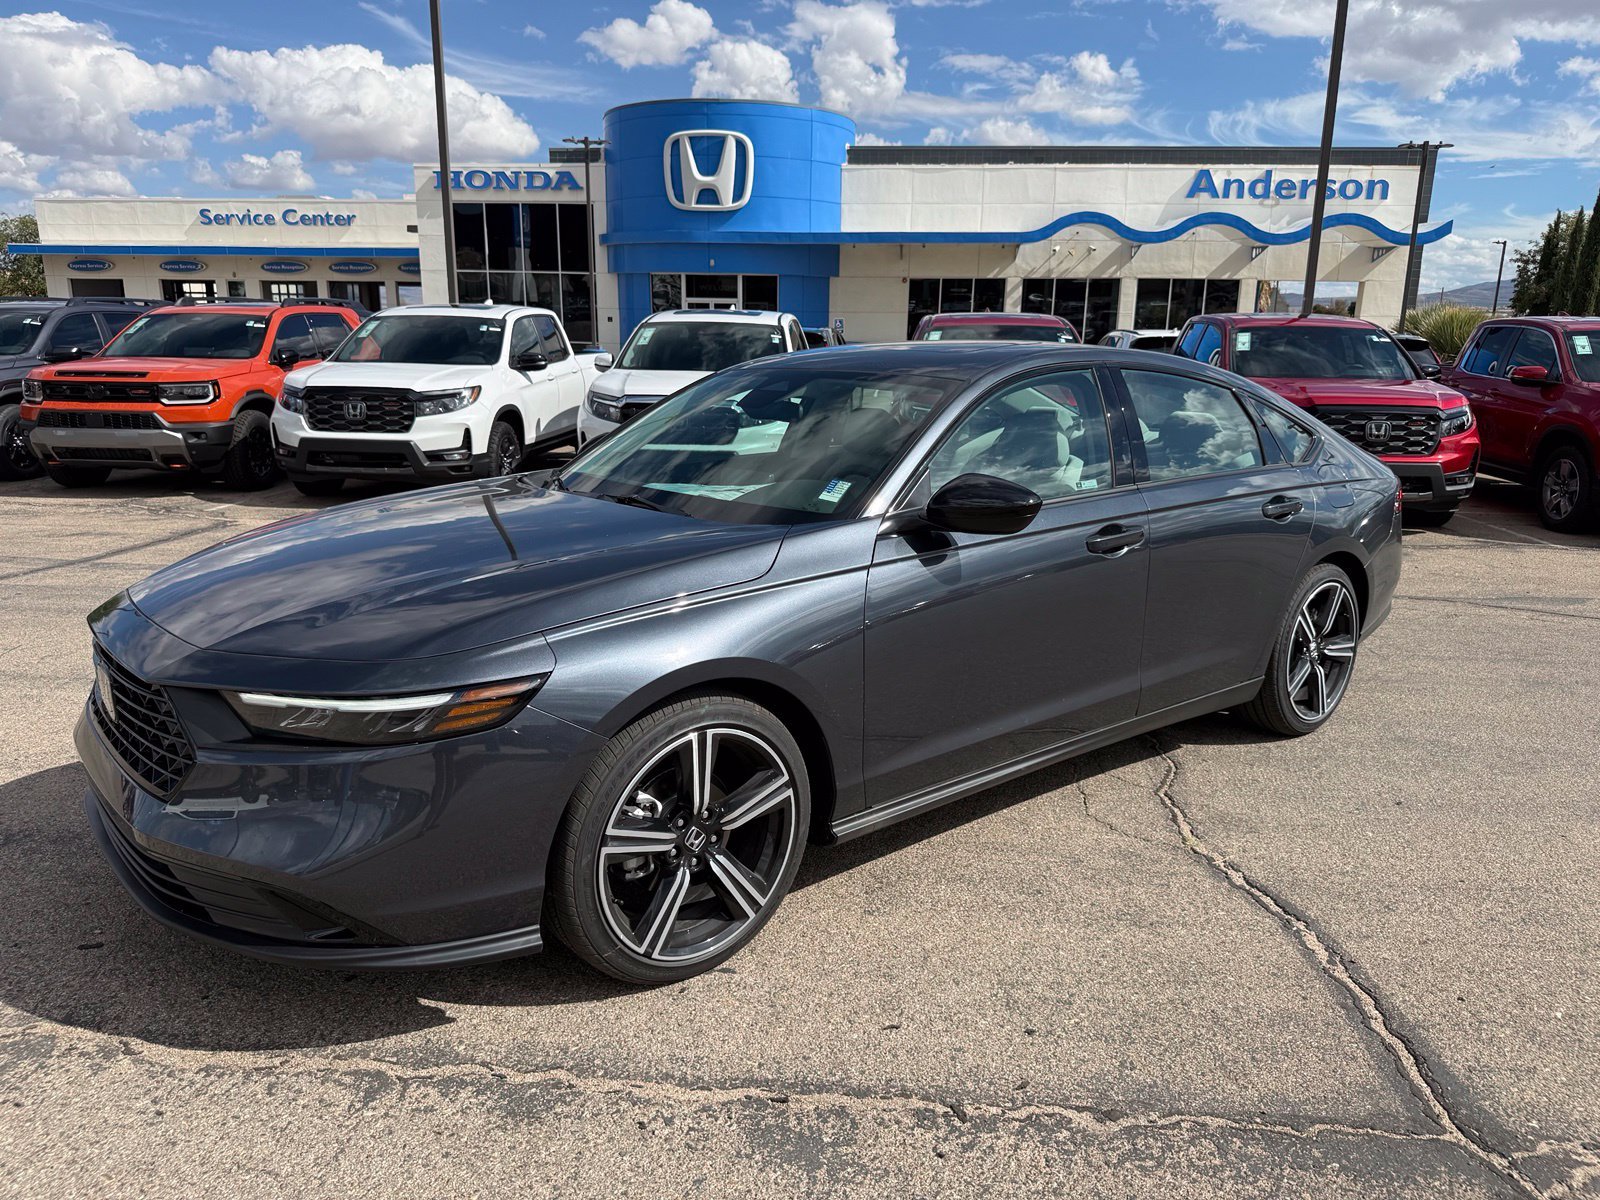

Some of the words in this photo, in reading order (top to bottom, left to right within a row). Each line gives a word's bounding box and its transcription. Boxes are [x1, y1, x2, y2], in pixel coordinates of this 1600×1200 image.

[432, 170, 584, 191] HONDA
[1186, 169, 1390, 200] Anderson
[198, 208, 276, 226] Service
[281, 208, 357, 226] Center
[161, 263, 179, 271] Express
